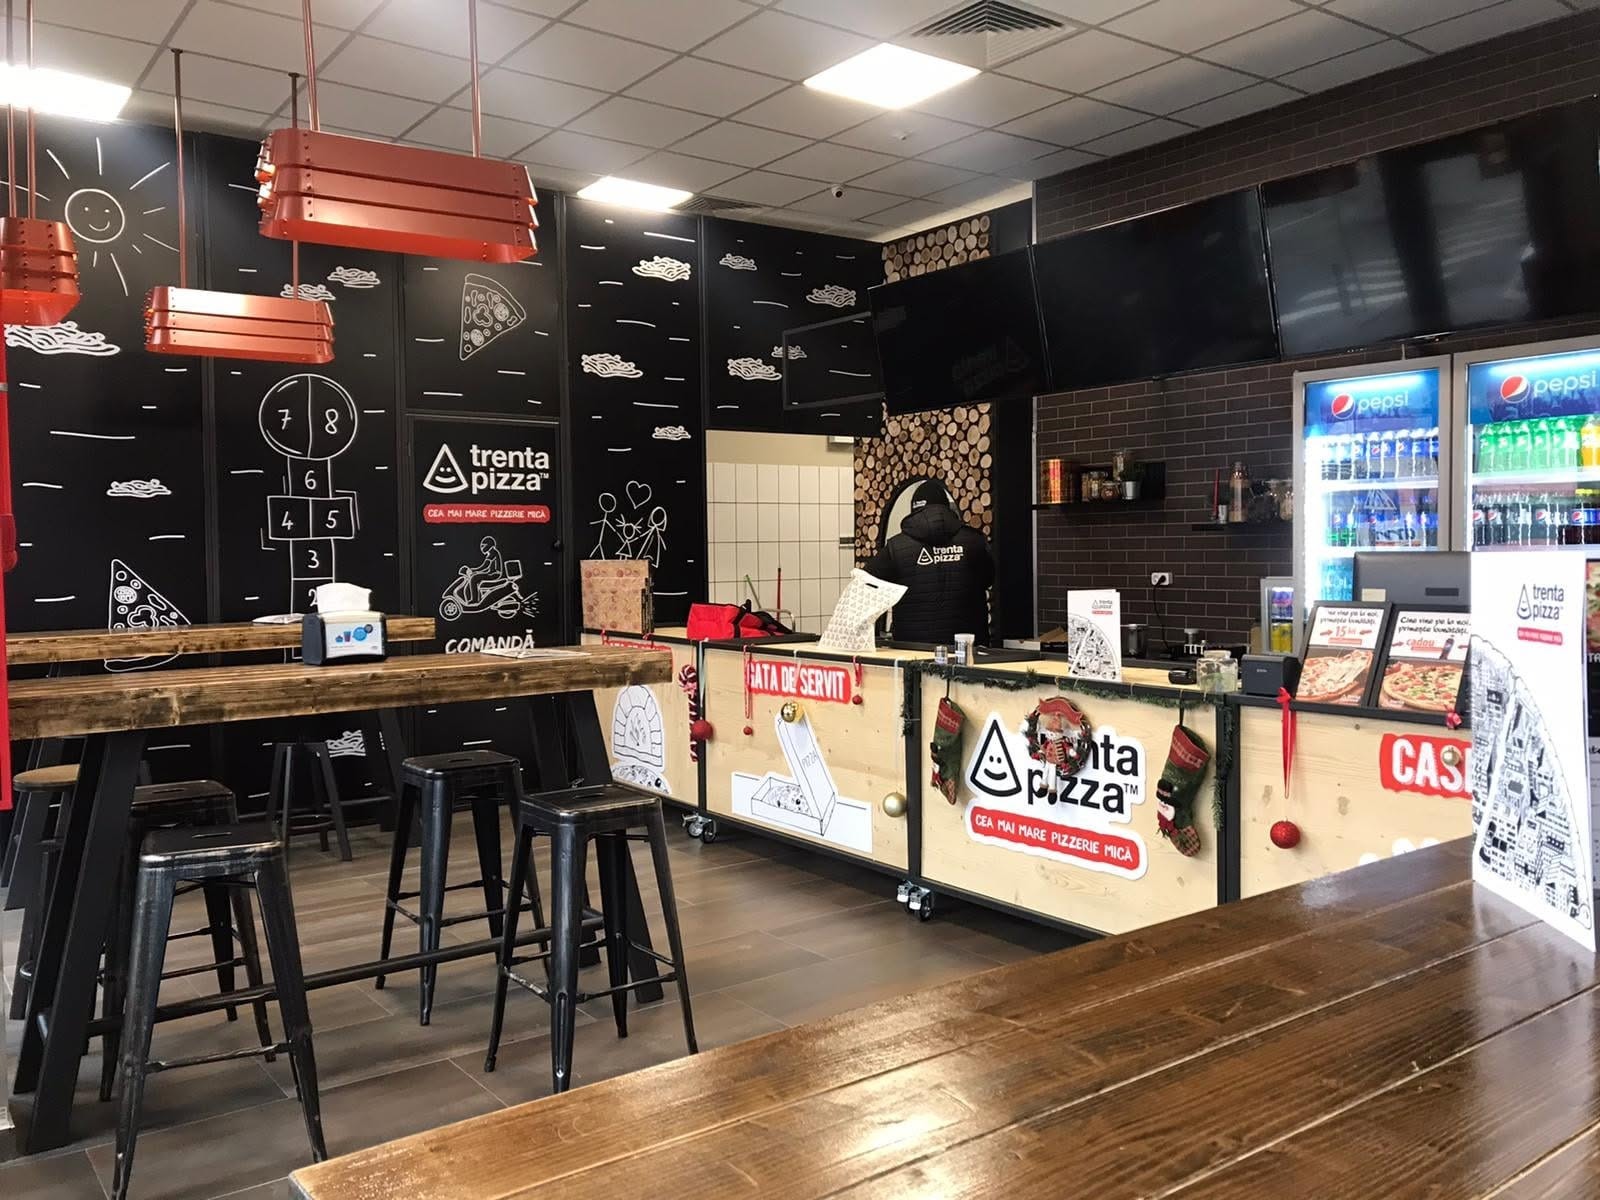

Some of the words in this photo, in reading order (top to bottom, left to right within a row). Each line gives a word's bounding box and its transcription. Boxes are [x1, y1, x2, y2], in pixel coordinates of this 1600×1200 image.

[1534, 369, 1598, 397] pepsi
[1357, 390, 1409, 414] pepsi
[277, 408, 292, 430] 7
[324, 408, 339, 434] 8
[469, 444, 550, 469] trenta
[304, 470, 317, 490] 6
[471, 467, 541, 495] pizza
[281, 511, 294, 531] 4
[325, 510, 340, 529] 5
[427, 509, 445, 518] CEA
[447, 509, 463, 518] MAI
[465, 509, 487, 518] MARE
[490, 510, 524, 518] PIZZERIE
[307, 550, 320, 569] 3
[932, 545, 964, 555] trenta
[934, 553, 961, 565] pizza
[1532, 583, 1565, 602] trenta
[1532, 601, 1560, 621] pizza
[1336, 626, 1347, 637] 15
[780, 665, 798, 694] DE
[799, 667, 845, 700] SERVIT
[1027, 766, 1125, 815] pzza
[975, 813, 994, 828] CEA
[997, 818, 1016, 835] MAI
[1018, 823, 1047, 842] MARE
[1051, 831, 1100, 855] PIZZERIE
